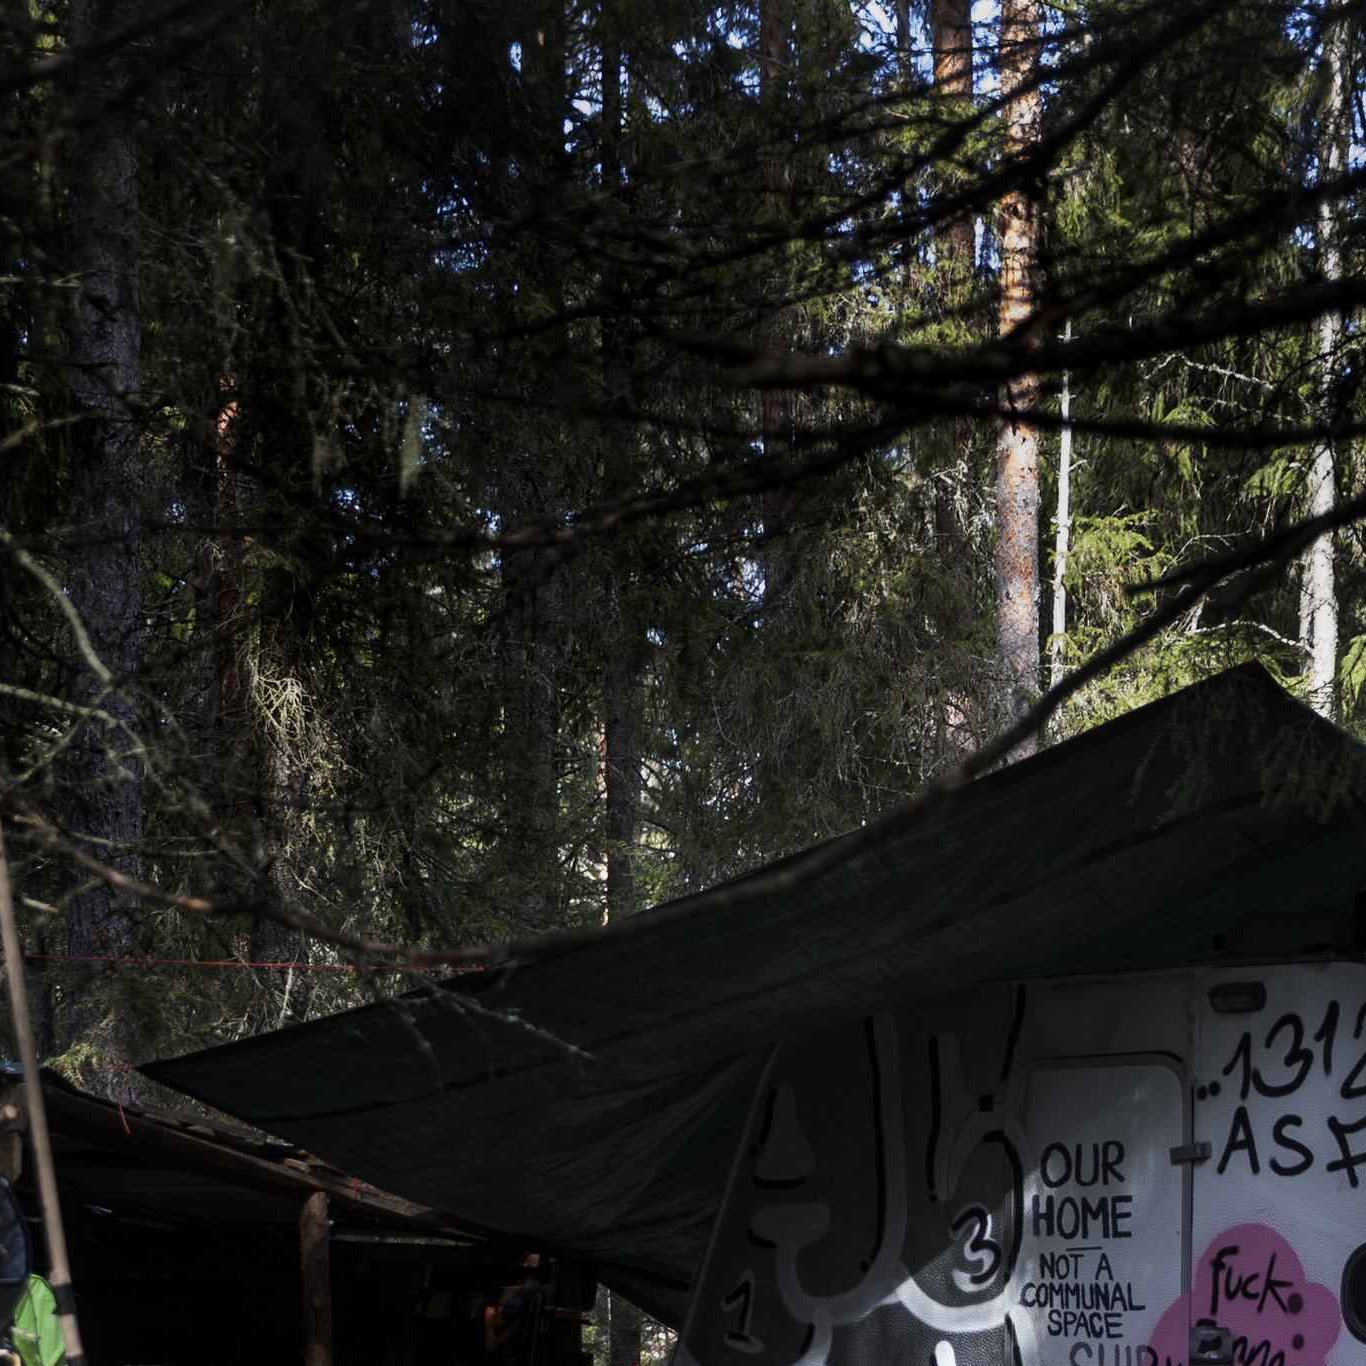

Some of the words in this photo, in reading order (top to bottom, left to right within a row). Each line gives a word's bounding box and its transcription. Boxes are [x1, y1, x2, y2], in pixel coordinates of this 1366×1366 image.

[1217, 1105, 1314, 1177] AS
[1040, 1140, 1125, 1188] OUR
[1032, 1195, 1133, 1240] HOME
[1039, 1252, 1084, 1280] NOT
[1095, 1252, 1114, 1281] A
[1020, 1282, 1146, 1312] COMMUNAL
[1047, 1308, 1123, 1339] SPACE
